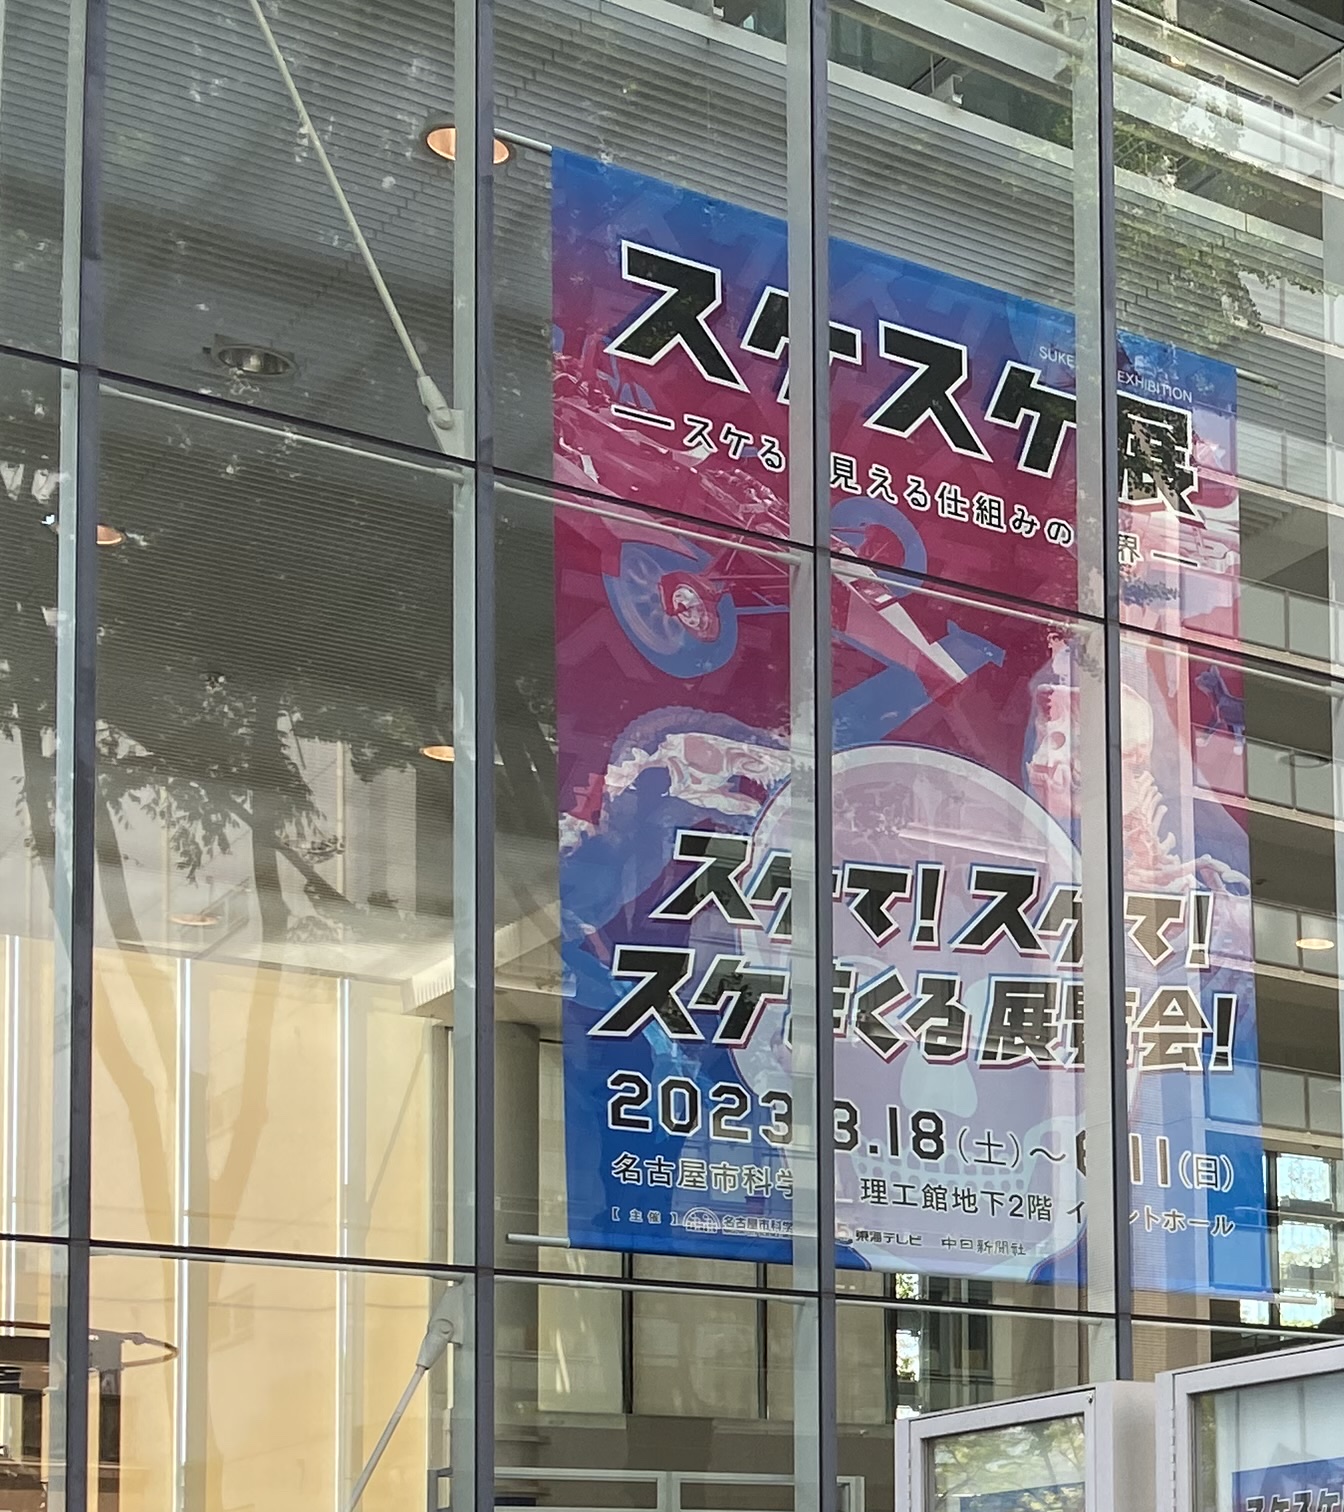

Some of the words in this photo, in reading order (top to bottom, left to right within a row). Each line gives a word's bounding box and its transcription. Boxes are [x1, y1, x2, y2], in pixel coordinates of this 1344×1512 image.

[1117, 370, 1193, 403] EXHIBITION
[861, 1178, 1054, 1225] 理工館地下2階
[856, 1230, 922, 1247] 東海テレビ
[941, 1238, 1027, 1257] 中日新聞社
